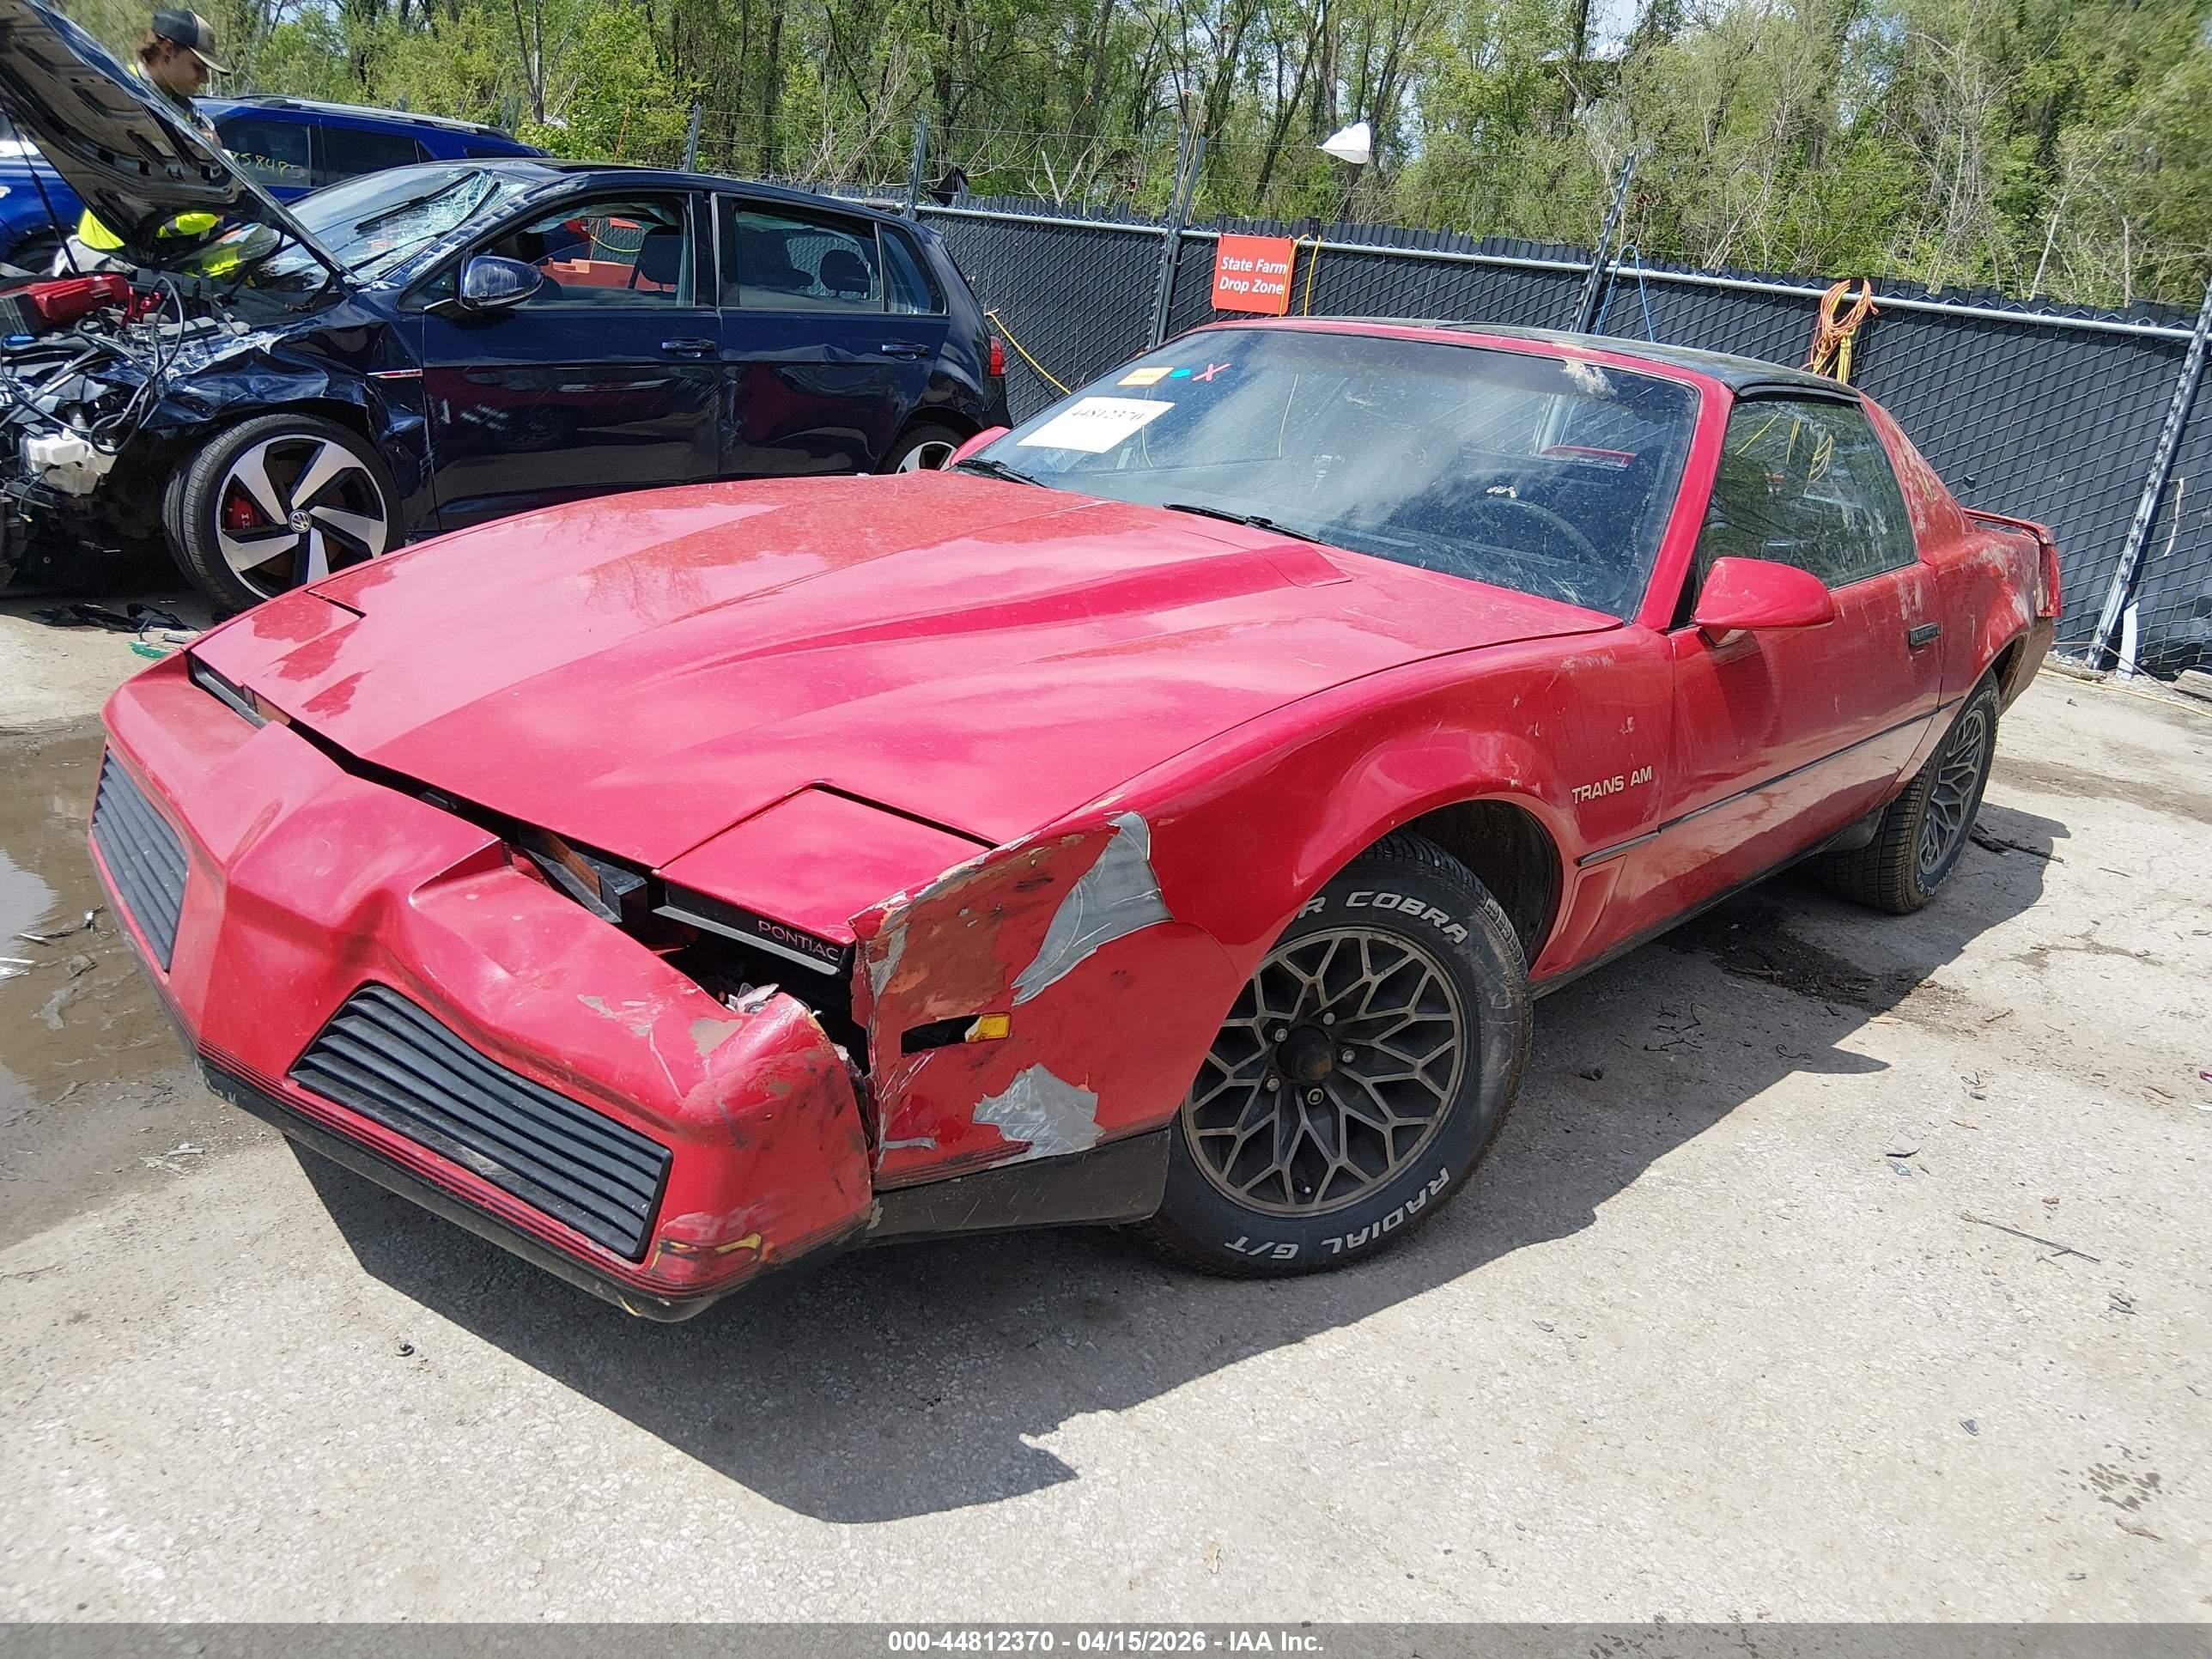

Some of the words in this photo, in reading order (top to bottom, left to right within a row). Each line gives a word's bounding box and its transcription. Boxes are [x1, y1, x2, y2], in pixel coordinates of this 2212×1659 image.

[1219, 276, 1249, 295] Drop
[1251, 279, 1284, 295] Zone
[1221, 257, 1253, 272] State
[1256, 258, 1287, 275] Farm
[1571, 775, 1625, 804] TRANS
[1630, 765, 1652, 787] AM
[1346, 891, 1468, 945] COBRA
[757, 920, 839, 961] PONTIAC
[1321, 1166, 1450, 1255] RADIAL
[1224, 1236, 1299, 1260] G/T
